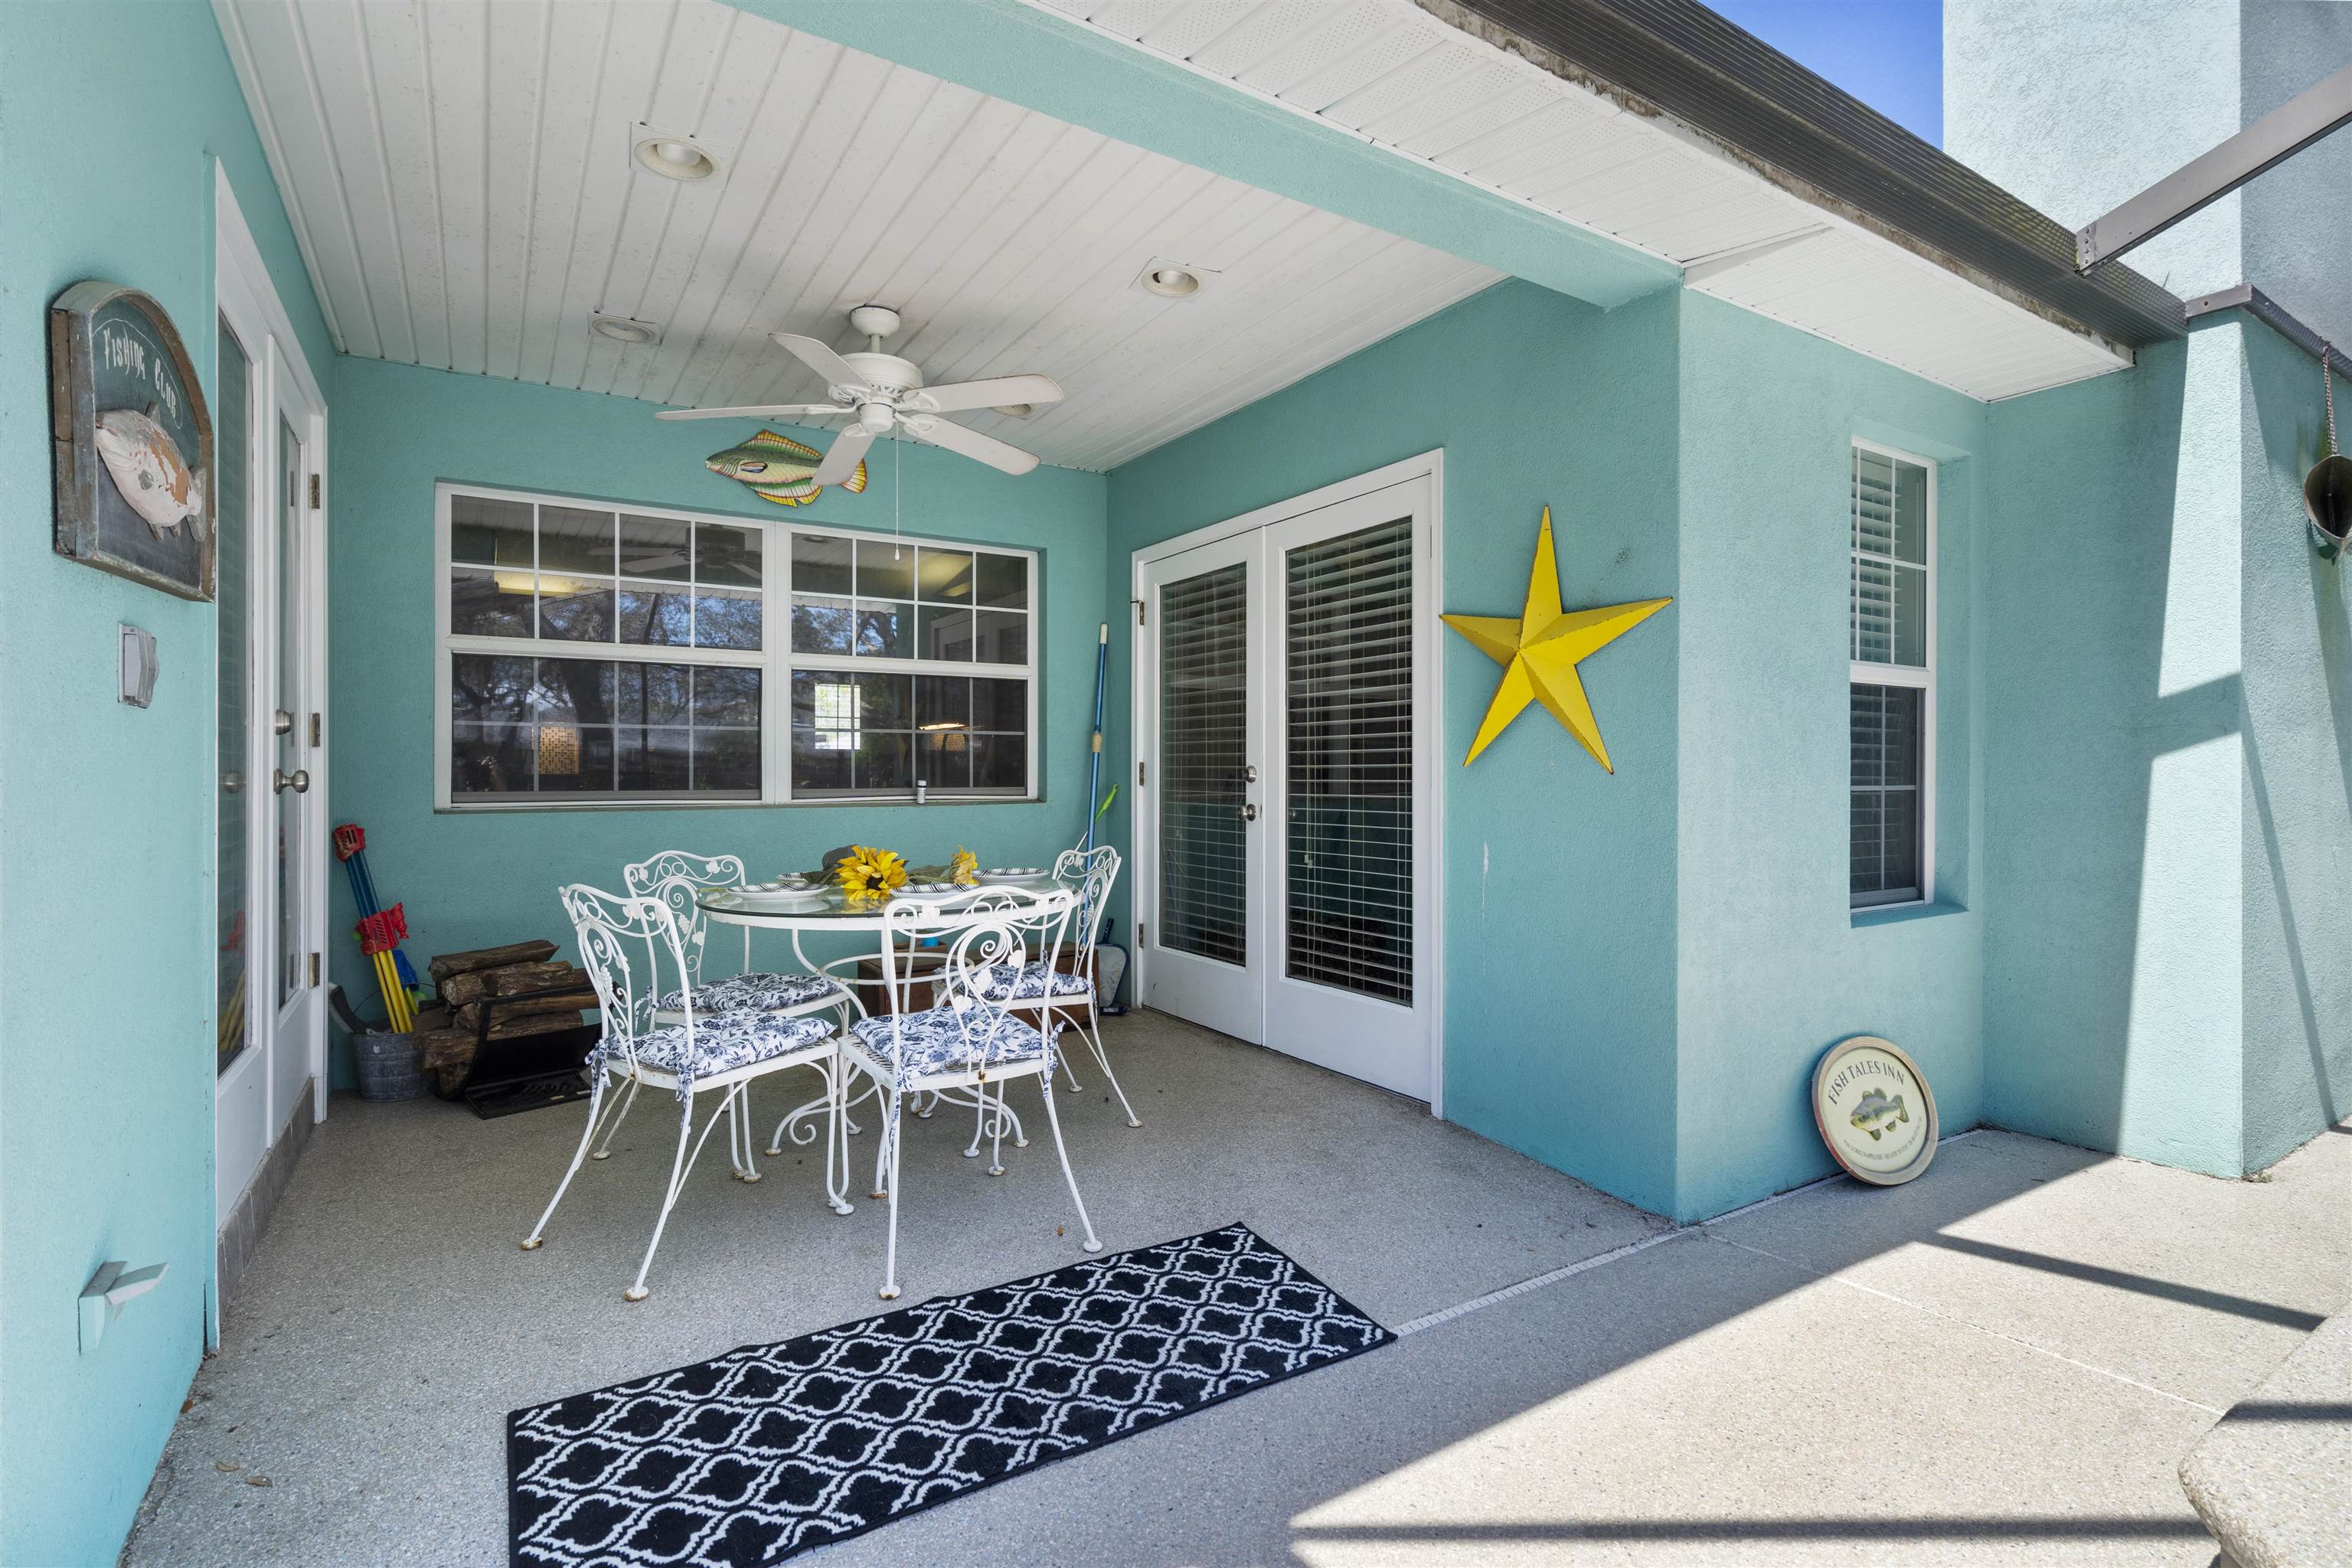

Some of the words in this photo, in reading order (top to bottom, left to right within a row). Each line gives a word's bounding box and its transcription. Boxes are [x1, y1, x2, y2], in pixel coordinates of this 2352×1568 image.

[155, 358, 176, 419] CLUB
[1828, 1070, 1849, 1106] FISH
[1847, 1060, 1881, 1080] TALES
[1882, 1062, 1905, 1085] INN
